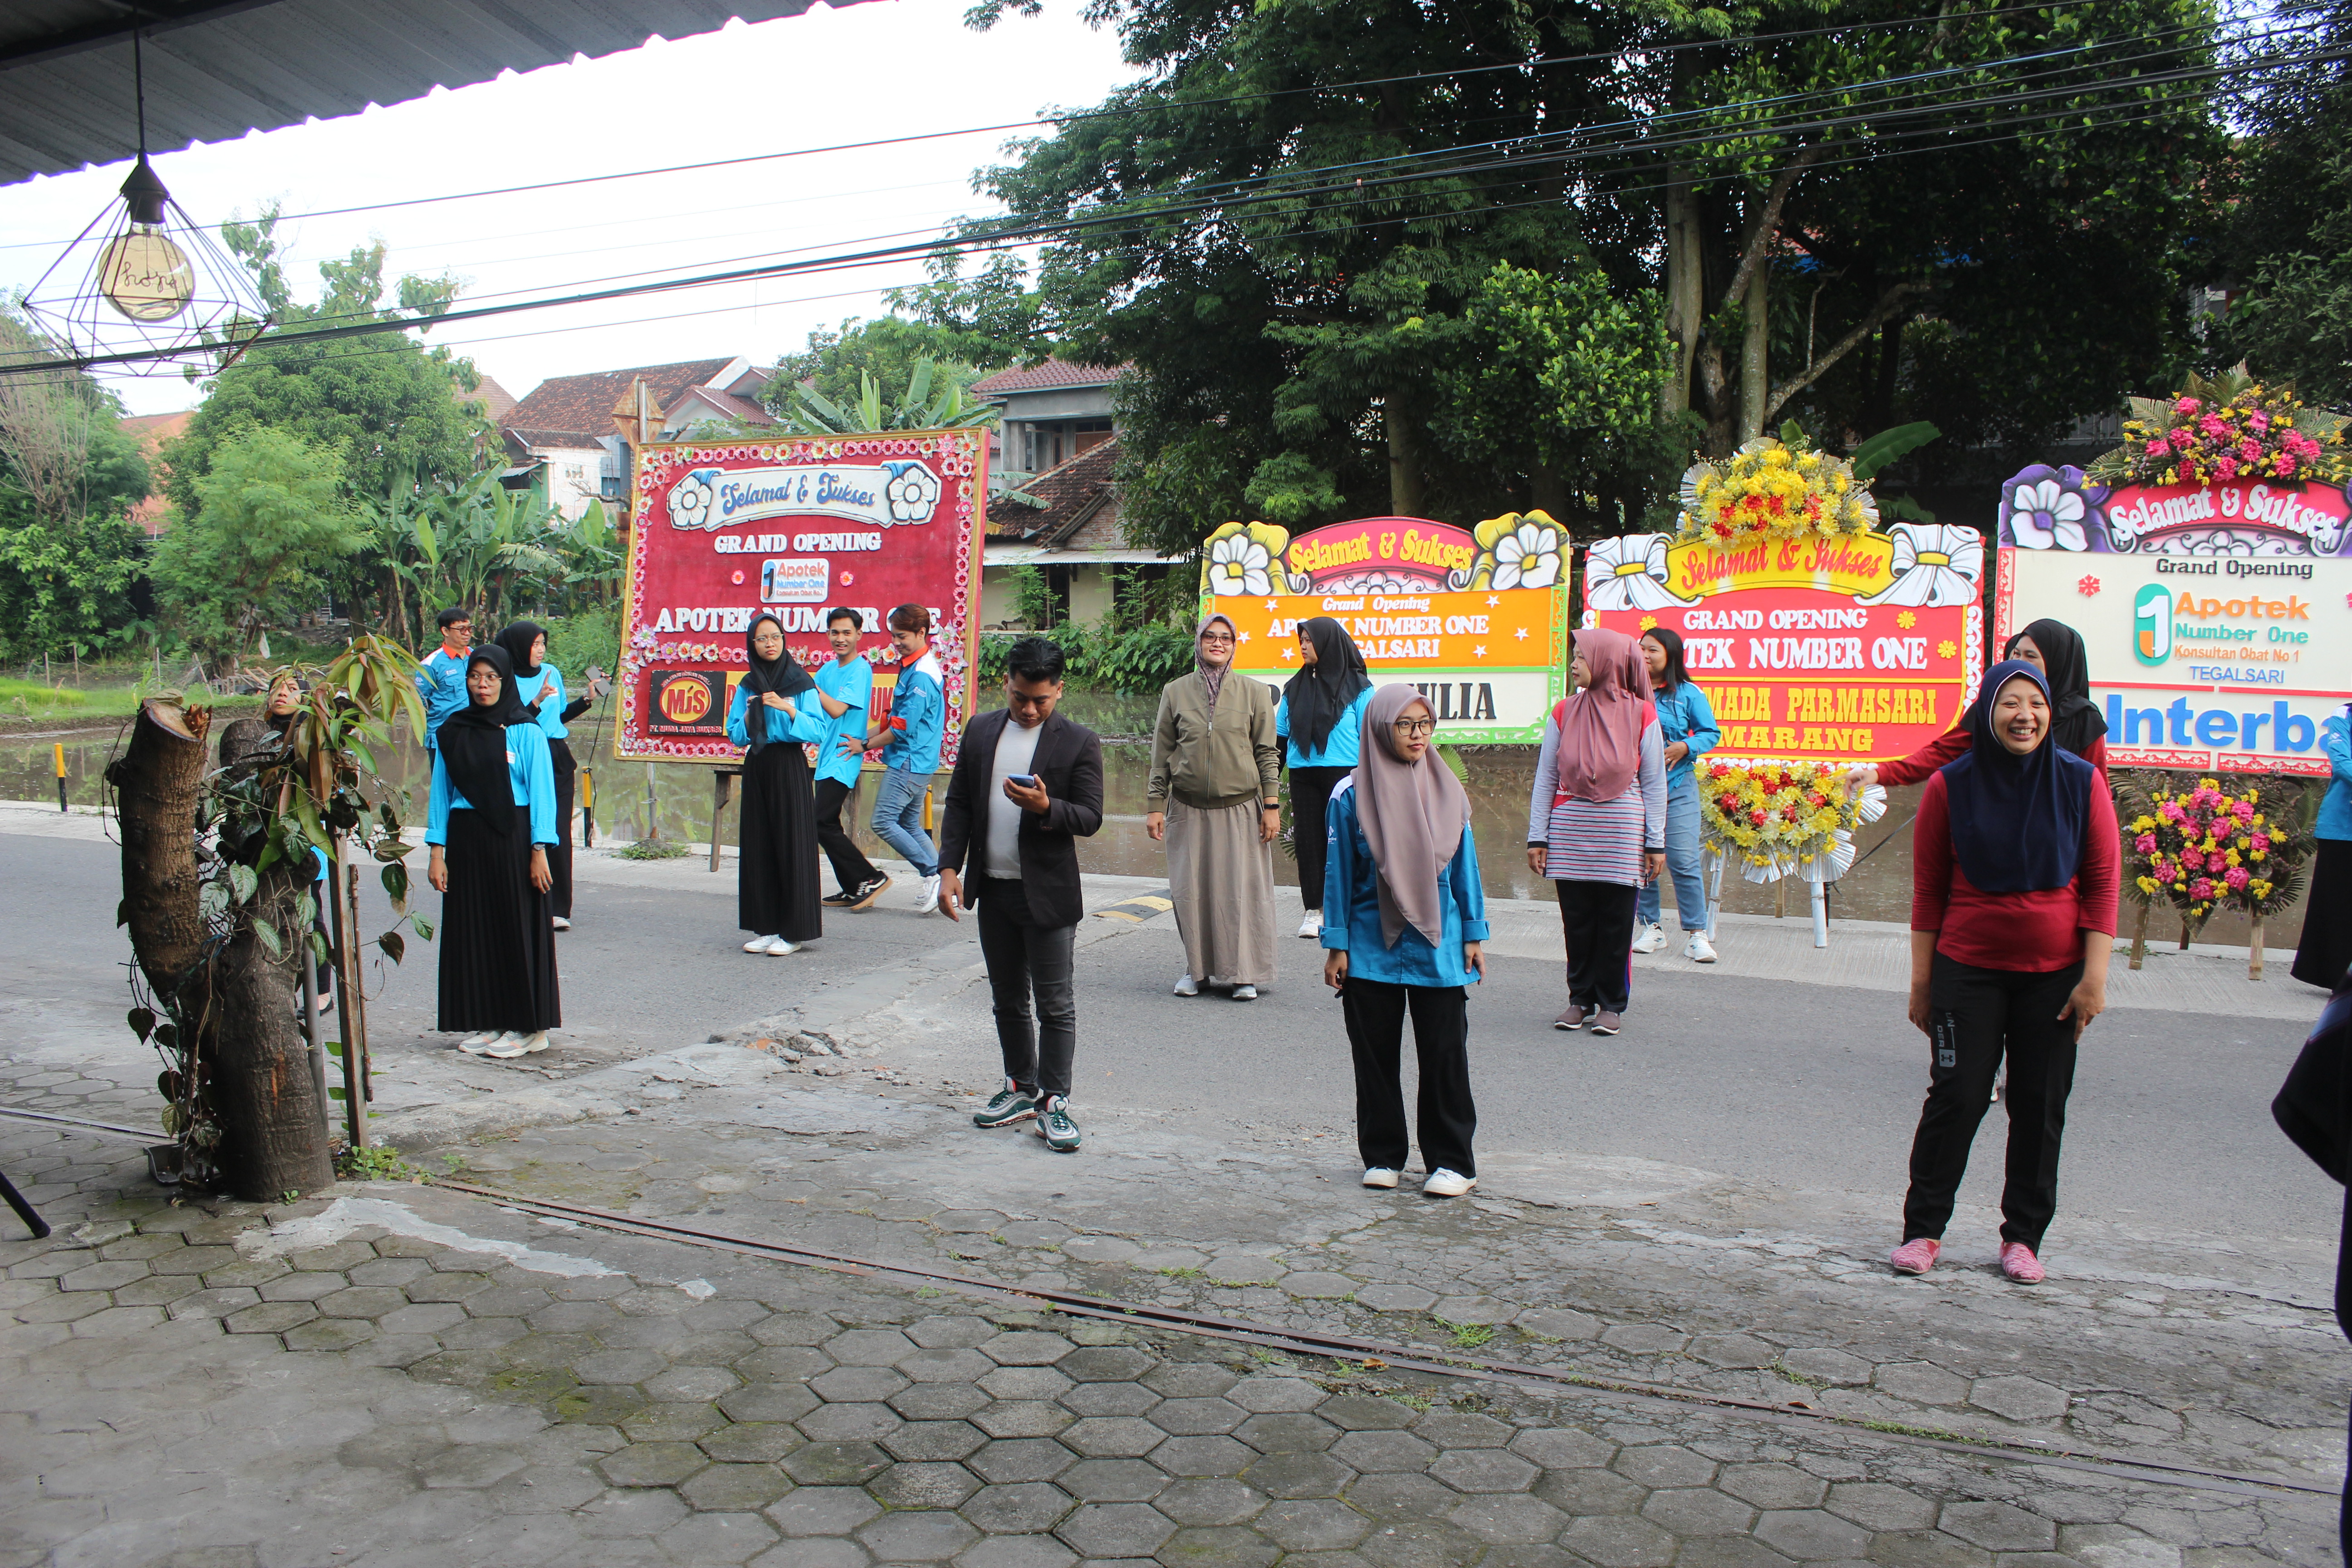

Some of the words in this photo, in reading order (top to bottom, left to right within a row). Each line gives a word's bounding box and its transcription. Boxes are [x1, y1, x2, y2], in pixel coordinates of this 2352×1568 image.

[721, 477, 793, 514] Selamat
[797, 475, 808, 503] &
[817, 472, 876, 506] Sukses
[2109, 486, 2215, 542] Selamat
[2220, 486, 2240, 517] &
[2244, 484, 2339, 542] Sukses
[714, 534, 788, 554] GRAND
[794, 532, 882, 552] OPENING
[1289, 532, 1371, 574] Selamat
[1379, 532, 1396, 559] &
[1400, 529, 1474, 571] Sukses
[777, 562, 825, 579] Apotek
[1681, 540, 1769, 589] Selamat
[1777, 538, 1802, 571] &
[1805, 538, 1883, 578] Sukses
[2156, 558, 2217, 575] Grand
[2226, 560, 2313, 579] Opening
[777, 579, 807, 588] Number
[808, 579, 825, 588] One
[1323, 597, 1363, 611] Grand
[1373, 597, 1430, 613] Opening
[2174, 592, 2310, 620] Apotek
[653, 607, 756, 633] APOTEK
[1267, 617, 1351, 637] APK
[1354, 616, 1442, 635] NUMBER
[1446, 615, 1489, 634] ONE
[1683, 610, 1763, 630] GRAND
[1769, 608, 1868, 629] OPENING
[2175, 622, 2257, 642] Number
[2269, 626, 2309, 644] One
[1353, 639, 1440, 659] GALSARI
[1683, 638, 1735, 669] TEK
[1748, 638, 1864, 669] NUMBER
[1871, 637, 1927, 669] ONE
[2174, 644, 2236, 659] Konsultan
[2239, 647, 2269, 661] Obat
[2273, 648, 2289, 662] No
[2293, 649, 2299, 662] 1
[2189, 666, 2284, 683] TEGALSARI
[1787, 688, 1937, 725] PARMASARI
[1717, 726, 1874, 752] MARANG
